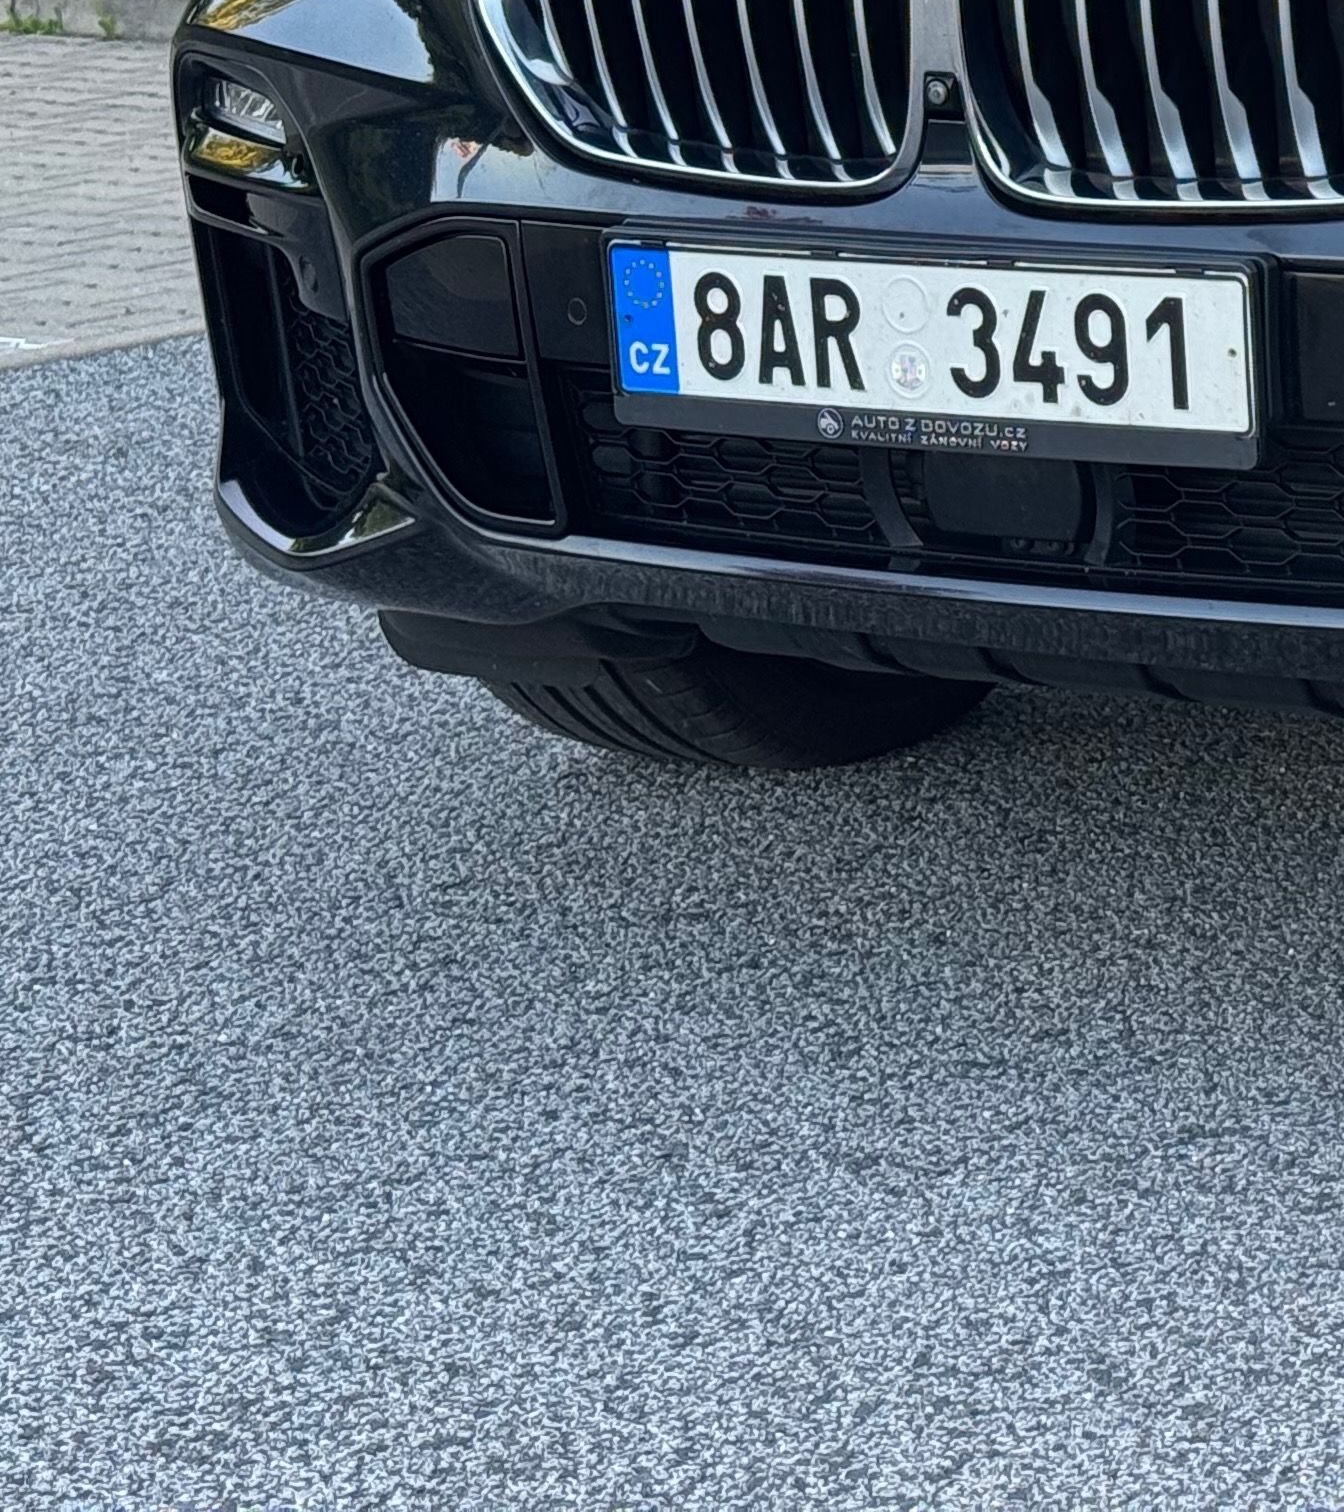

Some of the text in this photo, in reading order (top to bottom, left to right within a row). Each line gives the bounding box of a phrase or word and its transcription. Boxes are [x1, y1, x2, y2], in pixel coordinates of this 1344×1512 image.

[693, 271, 1190, 411] 8AR 3491
[629, 340, 671, 376] CZ
[851, 415, 900, 430] AUTO
[904, 418, 916, 432] Z
[851, 430, 912, 444] KVALITNÍ
